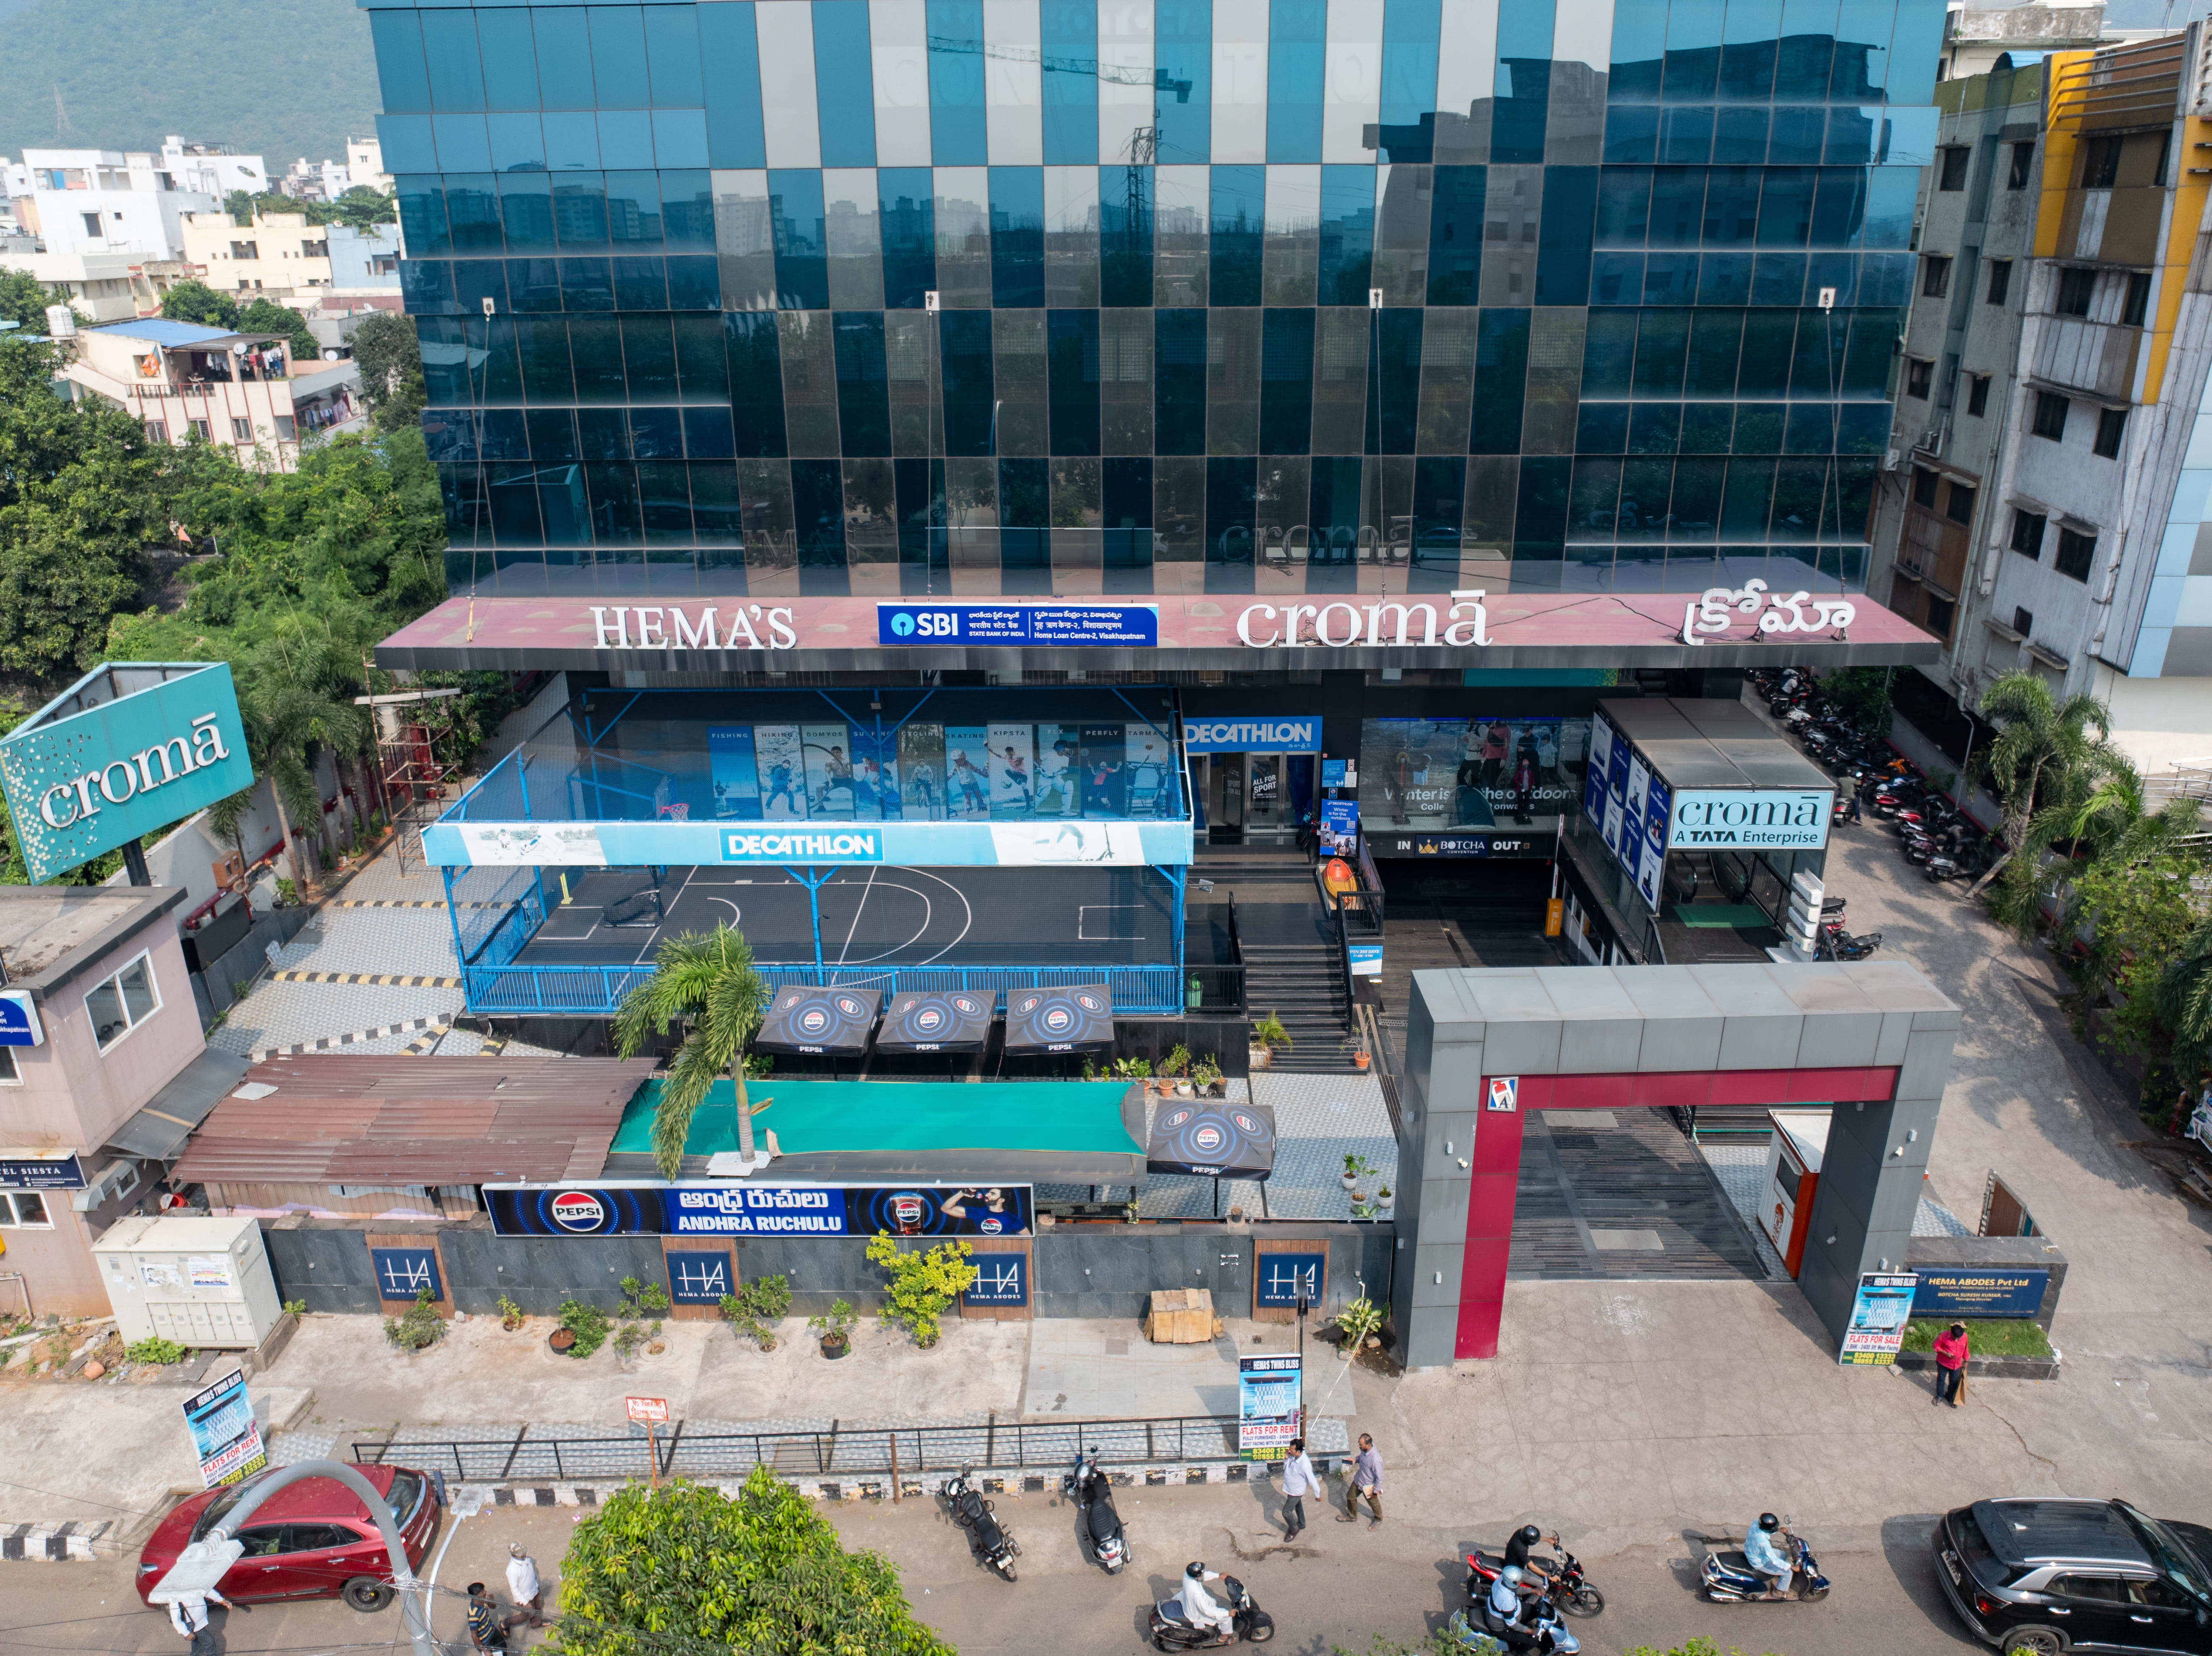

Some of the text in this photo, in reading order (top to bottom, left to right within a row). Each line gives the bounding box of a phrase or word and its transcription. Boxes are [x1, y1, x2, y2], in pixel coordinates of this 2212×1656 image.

[589, 604, 797, 649] HEMA'S
[917, 613, 958, 636] SBI
[1034, 622, 1043, 630] गृह
[1184, 723, 1312, 743] DECATHLON
[1254, 781, 1276, 793] SPORT
[728, 835, 874, 854] DECATHLON
[1398, 841, 1411, 850] IN
[1441, 841, 1485, 849] BOTCHA
[1492, 841, 1521, 850] OUT
[1675, 831, 1817, 845] A TATA Enterprise
[679, 1189, 829, 1213] ఆంధ్ర రుచులు
[556, 1207, 601, 1216] PEPSI
[678, 1216, 842, 1231] ANDHRA RUCHULU
[1890, 1277, 1904, 1286] TWINS
[1903, 1278, 1917, 1286] BLISS
[1270, 1359, 1285, 1369] TWINS
[1285, 1359, 1299, 1369] BLISS
[213, 1372, 242, 1397] TWINS BLISS
[203, 1434, 259, 1475] FLATS FOR RENT
[206, 1443, 260, 1479] FULLY FURNISHED 2400 SFT
[208, 1476, 218, 1485] WEST
[218, 1468, 231, 1480] FACING
[230, 1462, 240, 1472] WITH
[247, 1448, 262, 1461] PARKING
[220, 1454, 264, 1486] 83400 13333
[245, 1460, 266, 1476] 53333
